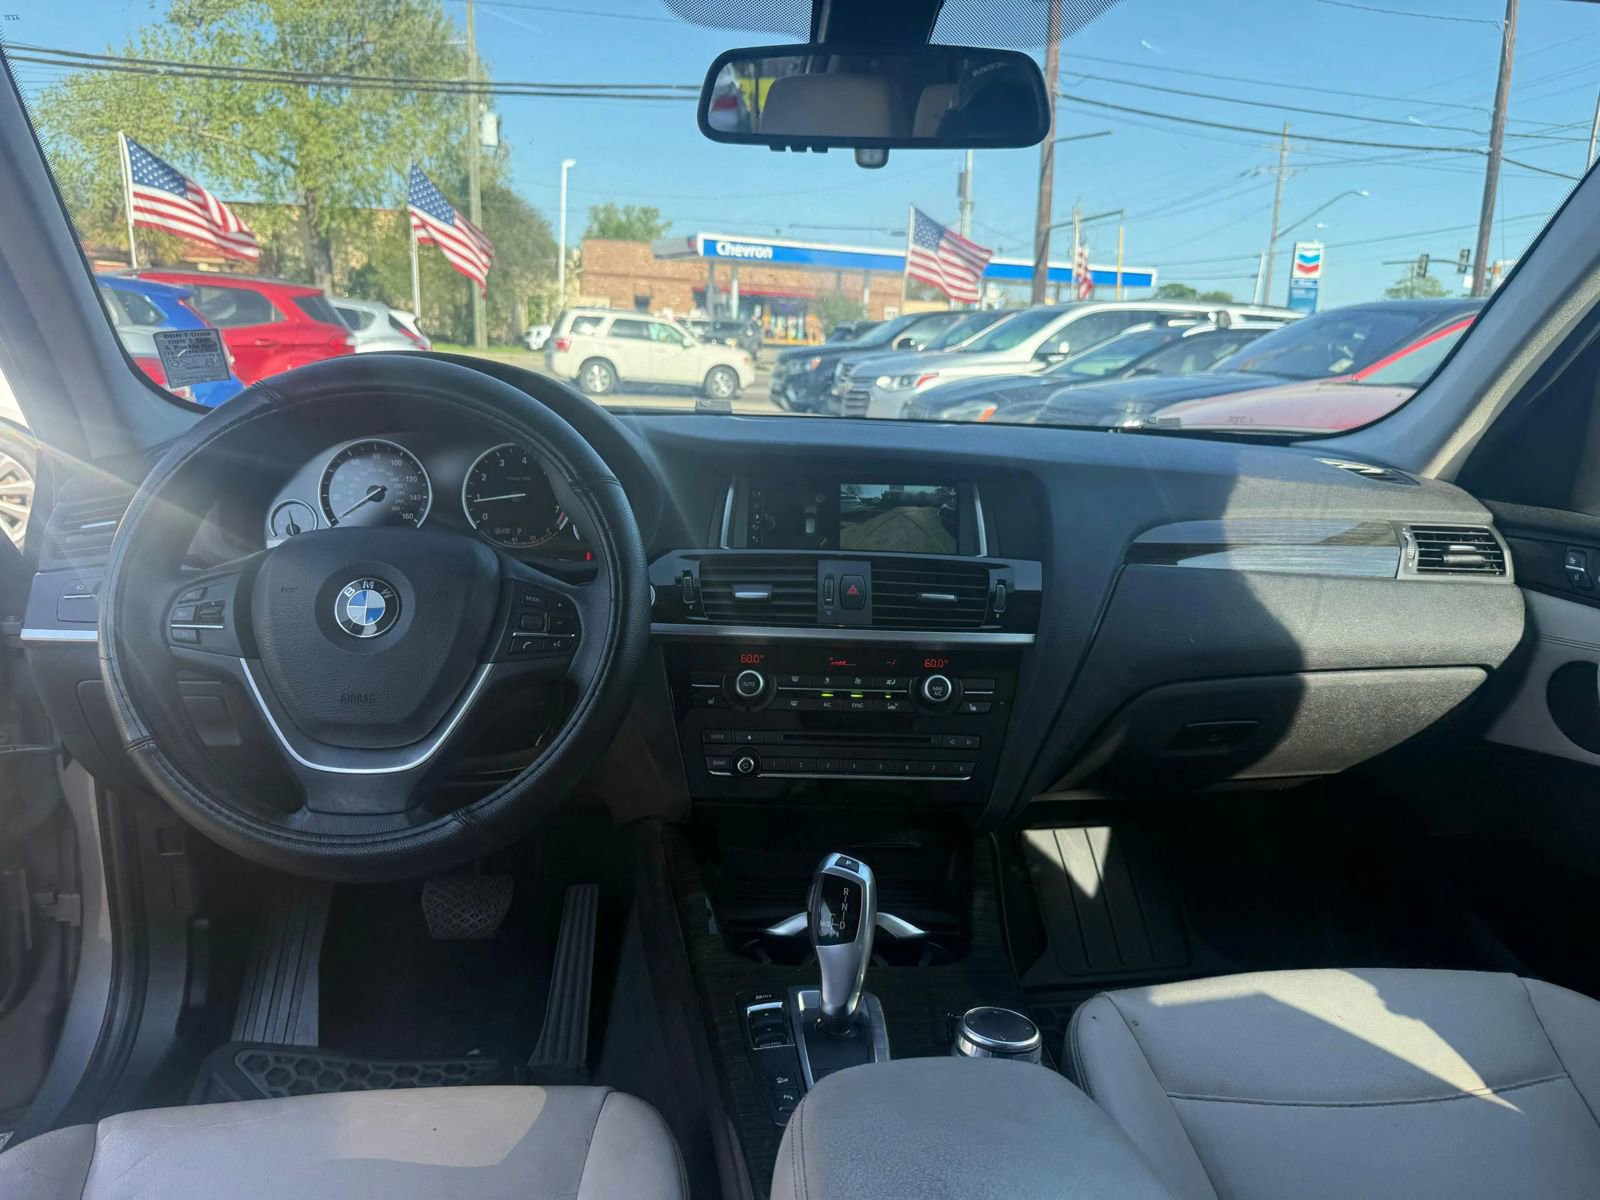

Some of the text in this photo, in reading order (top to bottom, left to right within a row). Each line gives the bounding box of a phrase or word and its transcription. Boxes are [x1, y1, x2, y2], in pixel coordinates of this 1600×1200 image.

[716, 242, 773, 260] Chevron
[500, 459, 505, 467] 3
[343, 581, 394, 598] BMW
[843, 887, 850, 896] R
[841, 902, 848, 911] N
[839, 921, 846, 929] D
